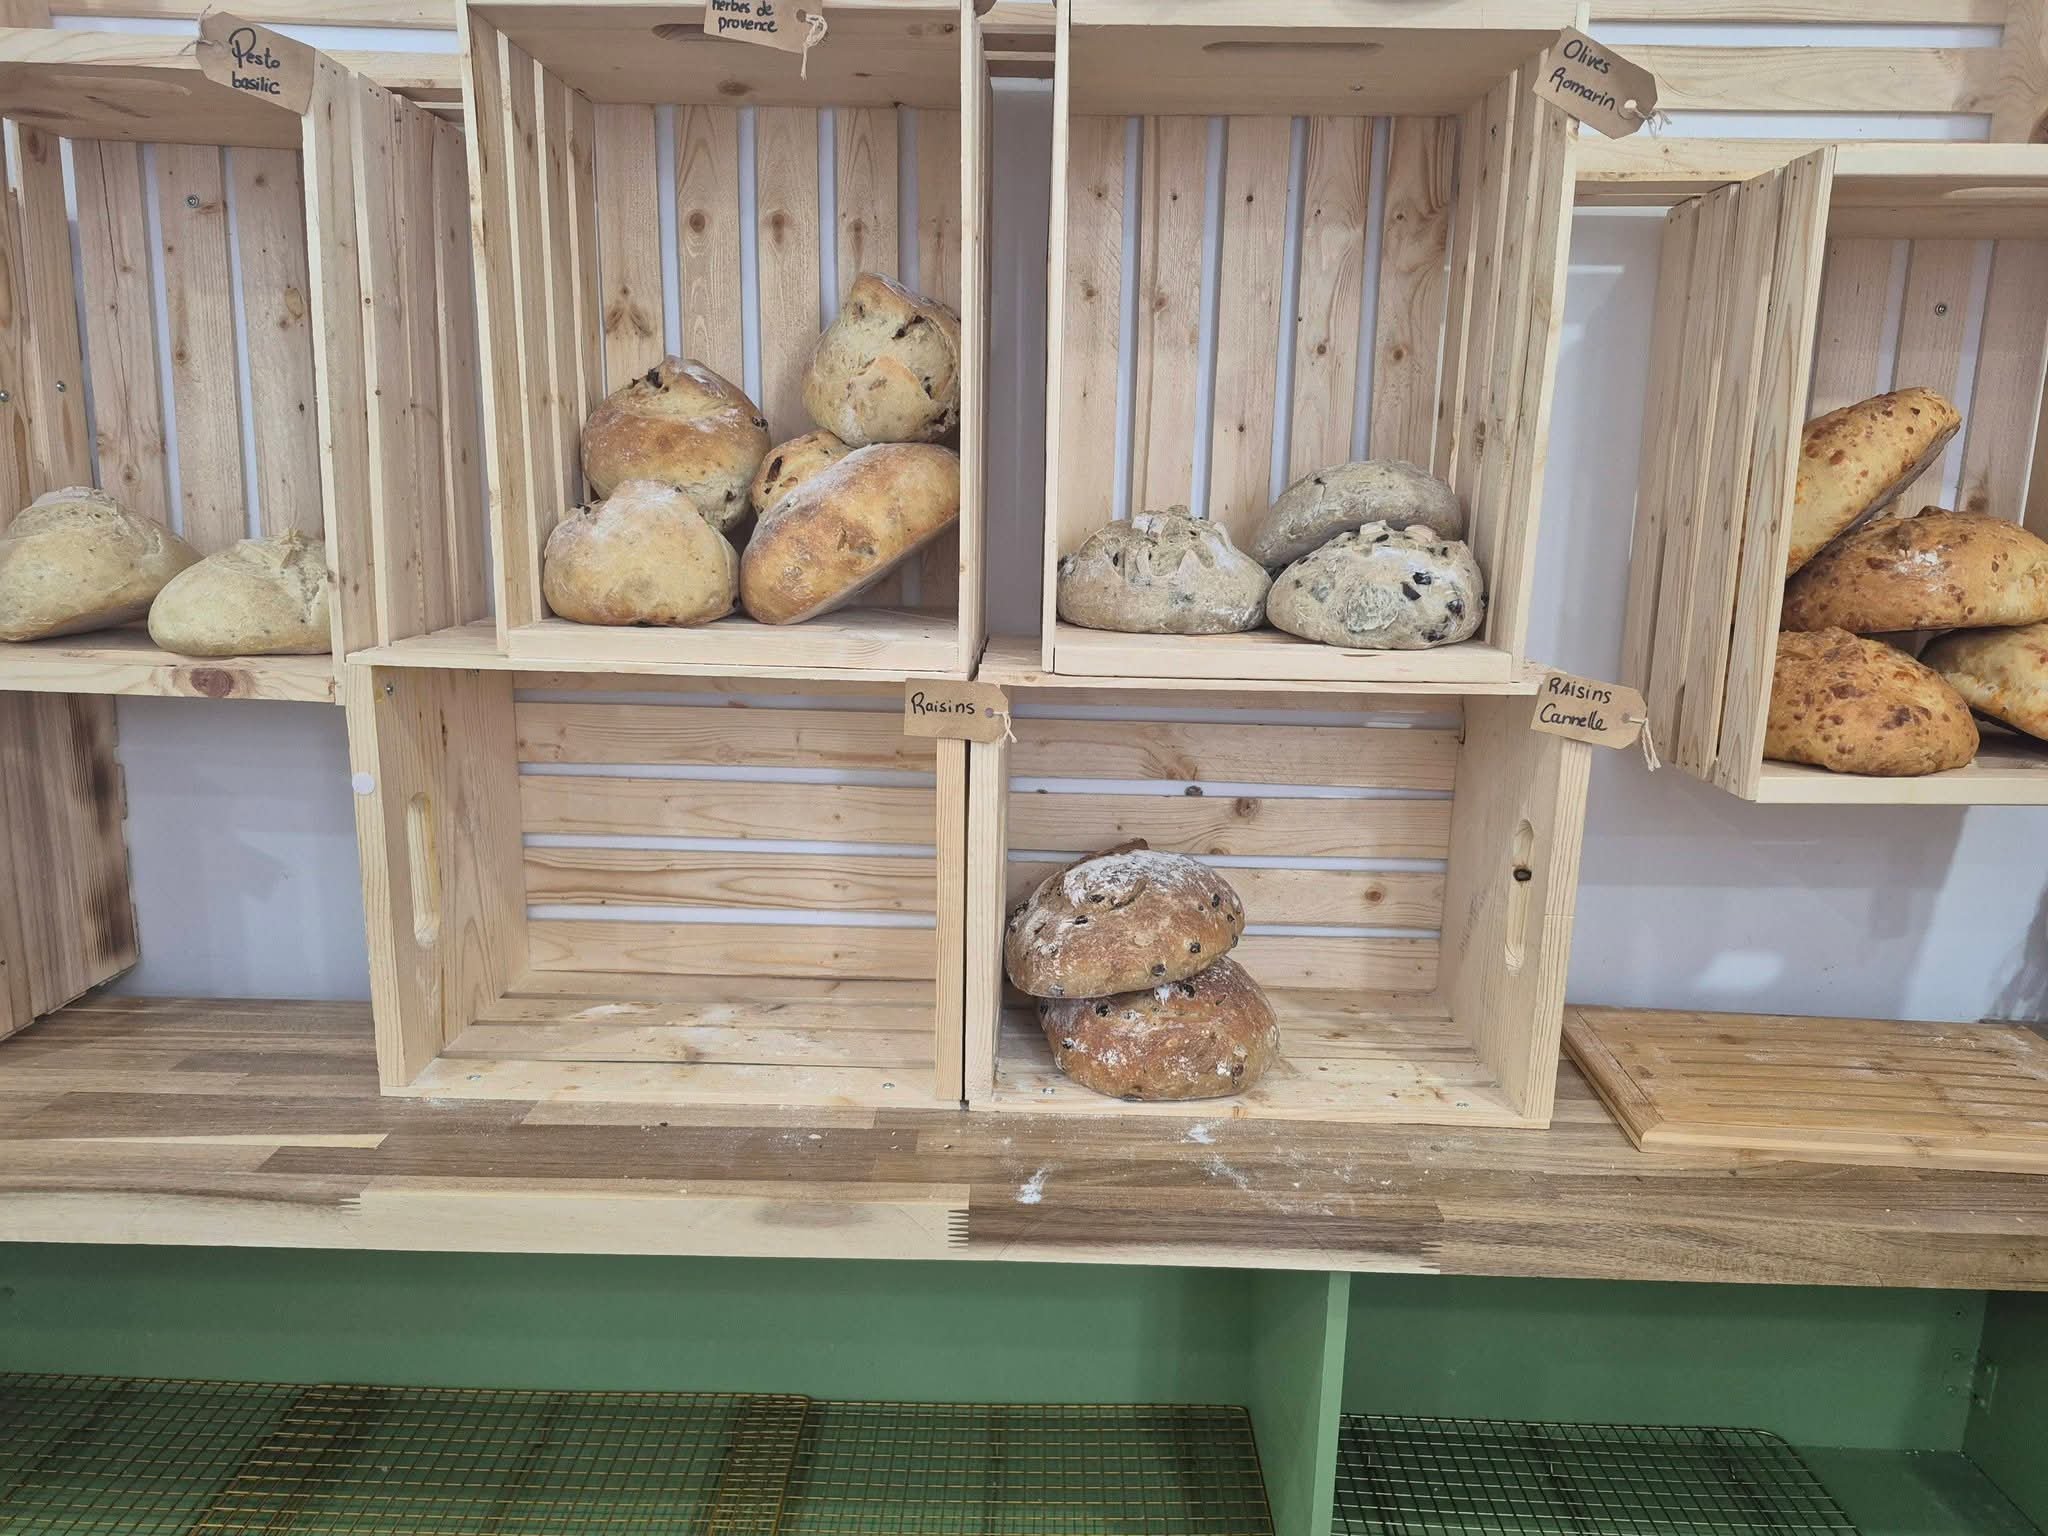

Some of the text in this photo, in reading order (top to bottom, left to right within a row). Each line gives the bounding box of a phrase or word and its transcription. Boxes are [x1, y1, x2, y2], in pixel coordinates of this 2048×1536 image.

[756, 0, 774, 17] de
[718, 16, 778, 33] provence
[229, 27, 281, 69] Pesto
[1563, 39, 1611, 74] Olives
[231, 70, 281, 95] basilic
[1549, 66, 1616, 111] Romarin
[911, 691, 975, 715] Raisins
[1539, 702, 1608, 732] Cannelle
